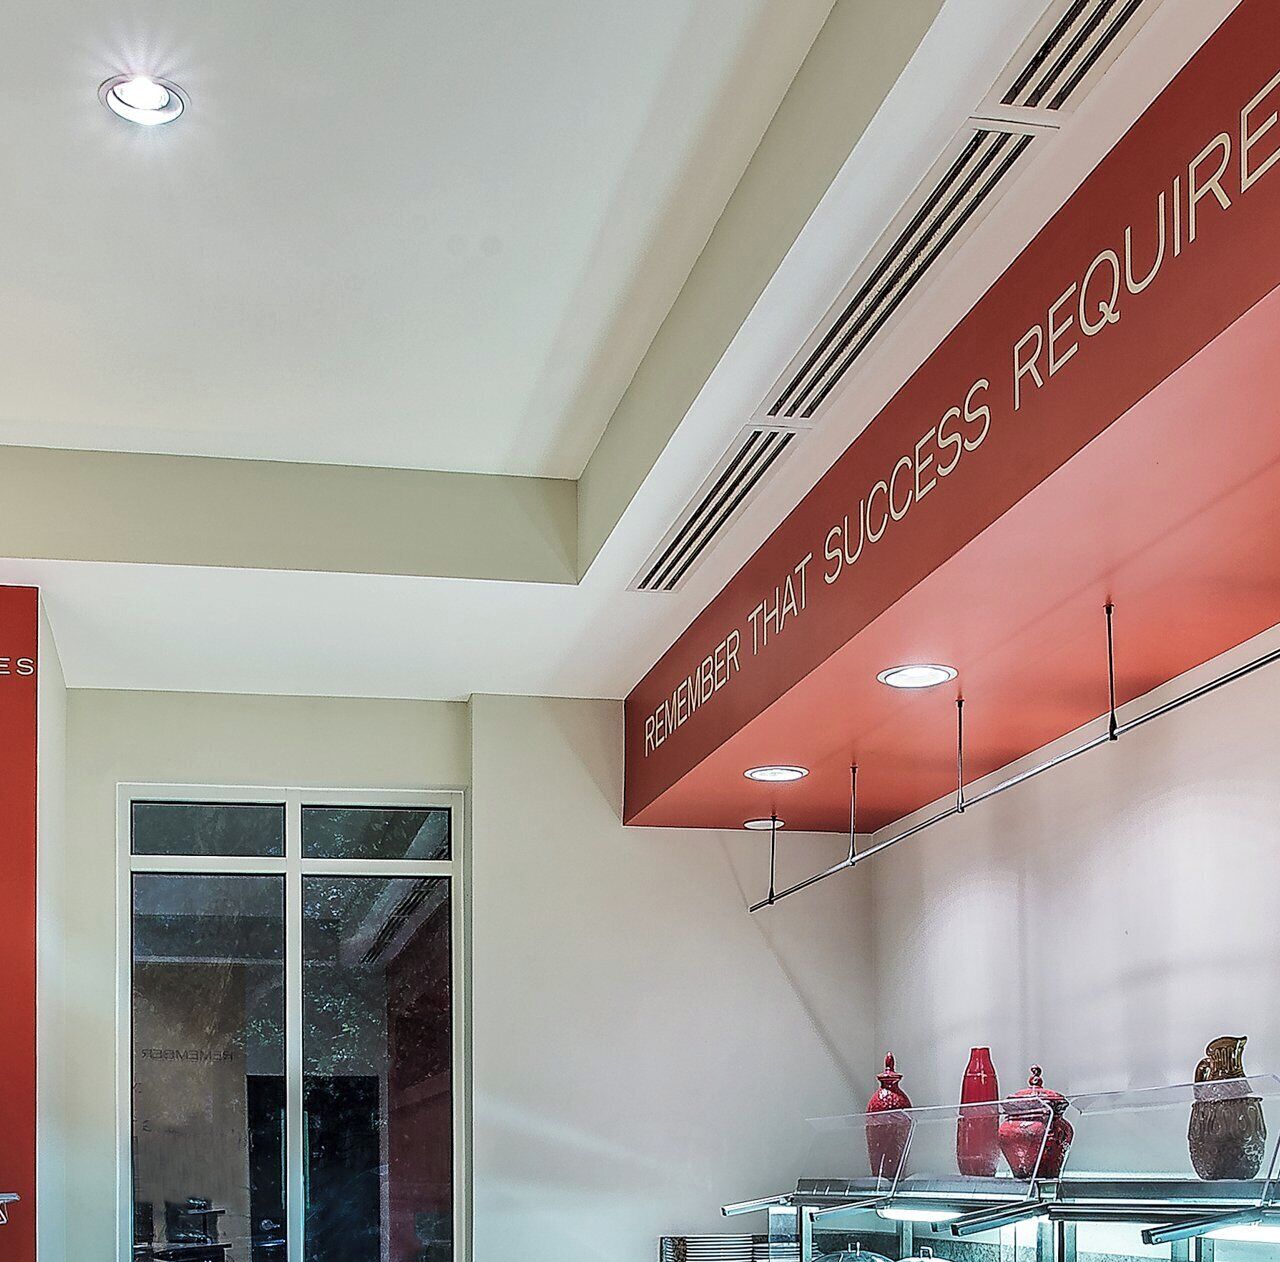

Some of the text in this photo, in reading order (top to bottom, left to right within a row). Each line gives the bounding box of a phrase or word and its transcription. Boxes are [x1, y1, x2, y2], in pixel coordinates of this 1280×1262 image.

[644, 629, 740, 757] REMEMBER
[747, 552, 812, 656] THAT
[824, 378, 991, 584] SUCCESS
